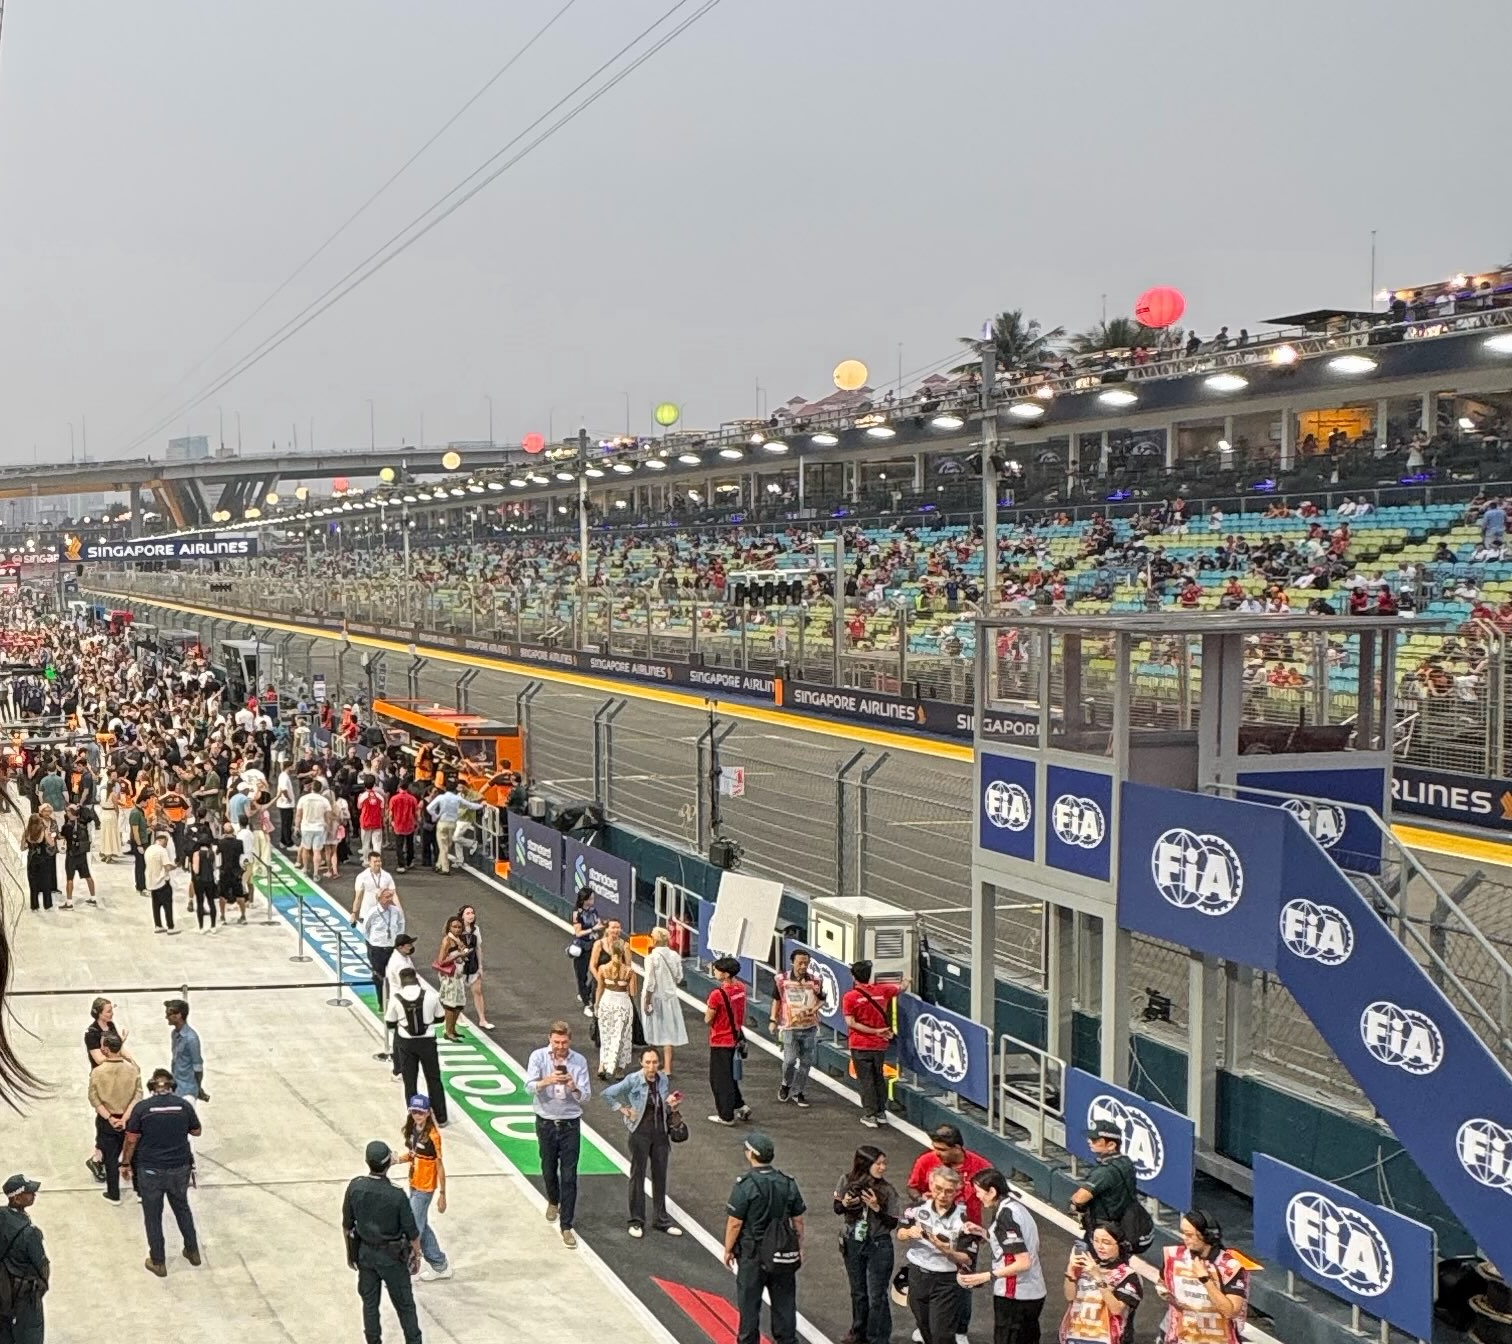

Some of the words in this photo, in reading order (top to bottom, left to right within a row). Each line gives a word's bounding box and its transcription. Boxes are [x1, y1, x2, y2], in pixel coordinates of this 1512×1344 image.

[88, 544, 175, 558] SINGAPORE
[179, 541, 248, 556] AIRLINES
[690, 670, 740, 688] SINGAPORE
[743, 677, 774, 692] AIRLIN
[794, 689, 857, 712] SINGAPORE
[859, 699, 915, 721] AIRLINES
[1391, 777, 1492, 814] RLINES
